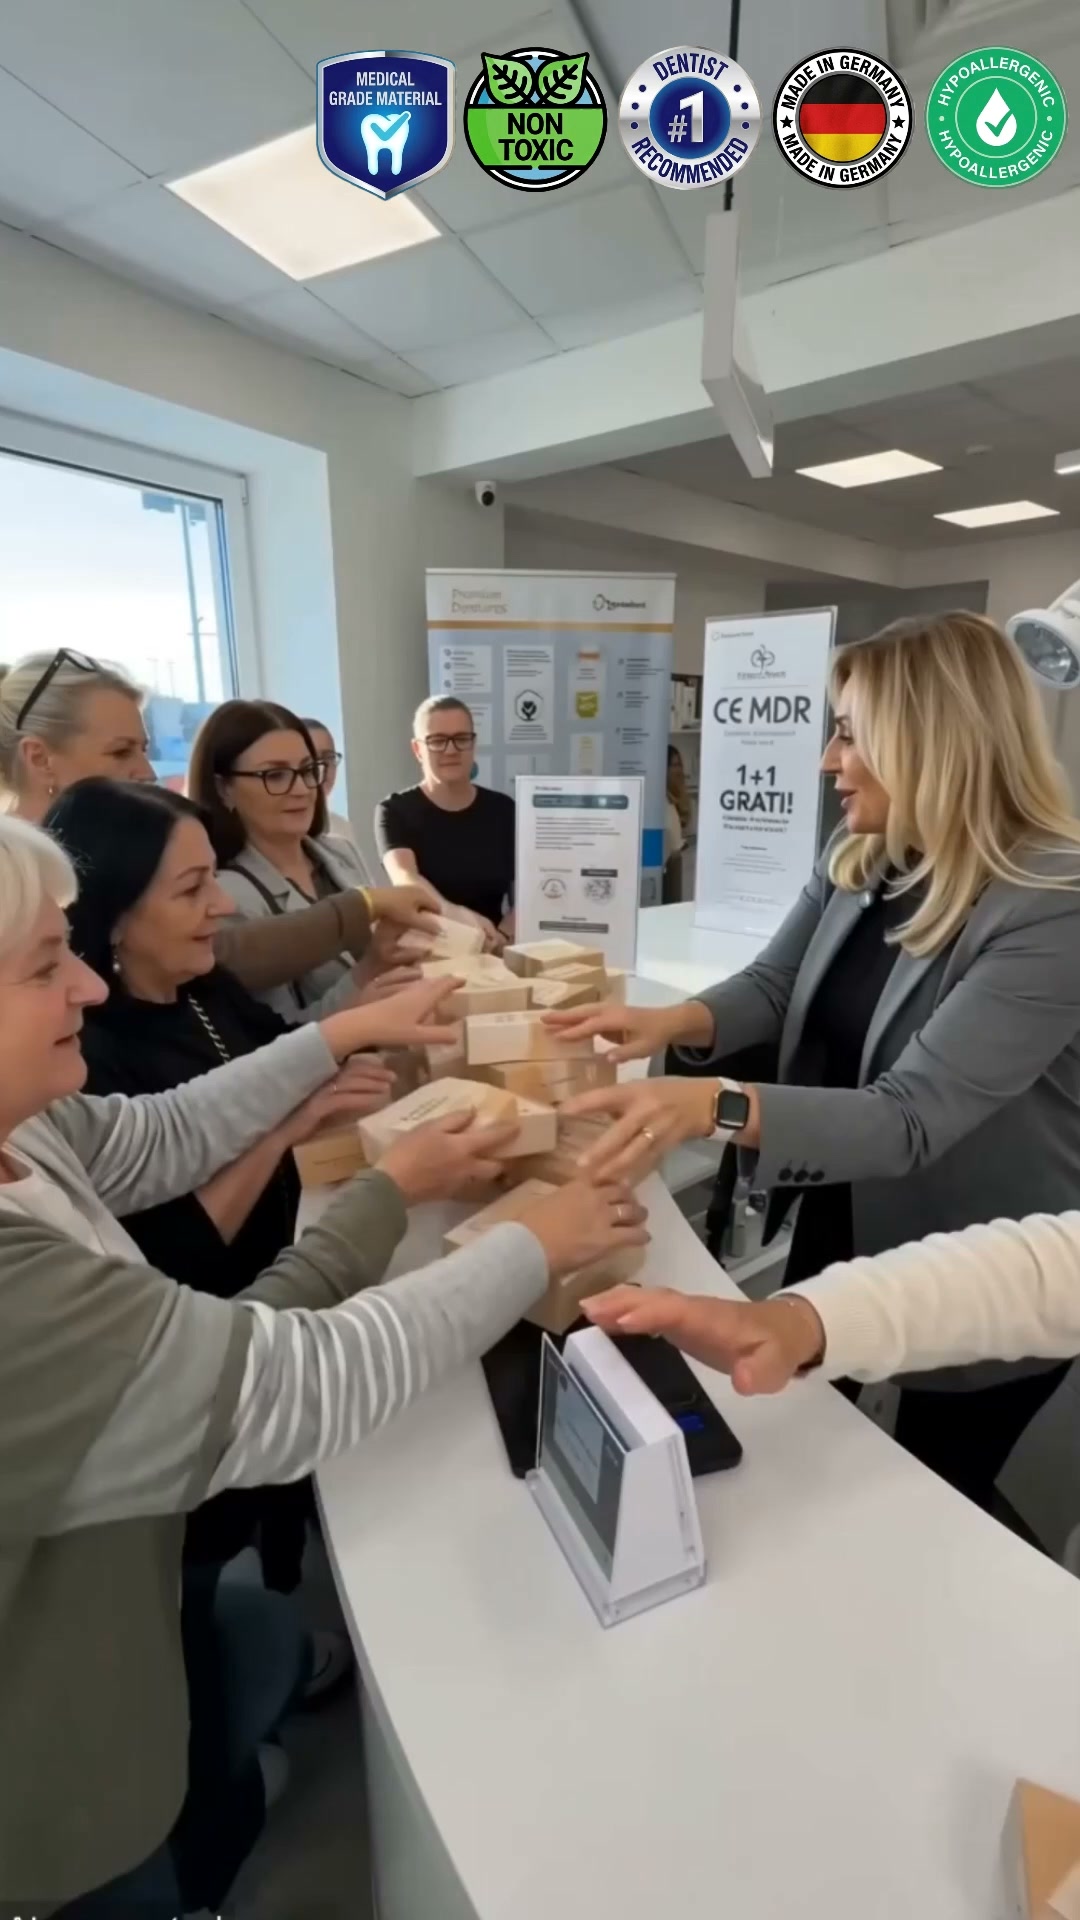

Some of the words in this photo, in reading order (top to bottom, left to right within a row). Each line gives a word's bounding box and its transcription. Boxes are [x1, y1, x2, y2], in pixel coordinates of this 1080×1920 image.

[713, 697, 743, 724] CE
[749, 696, 811, 724] MDR
[736, 764, 776, 786] 1+1
[720, 789, 793, 814] GRATI!
